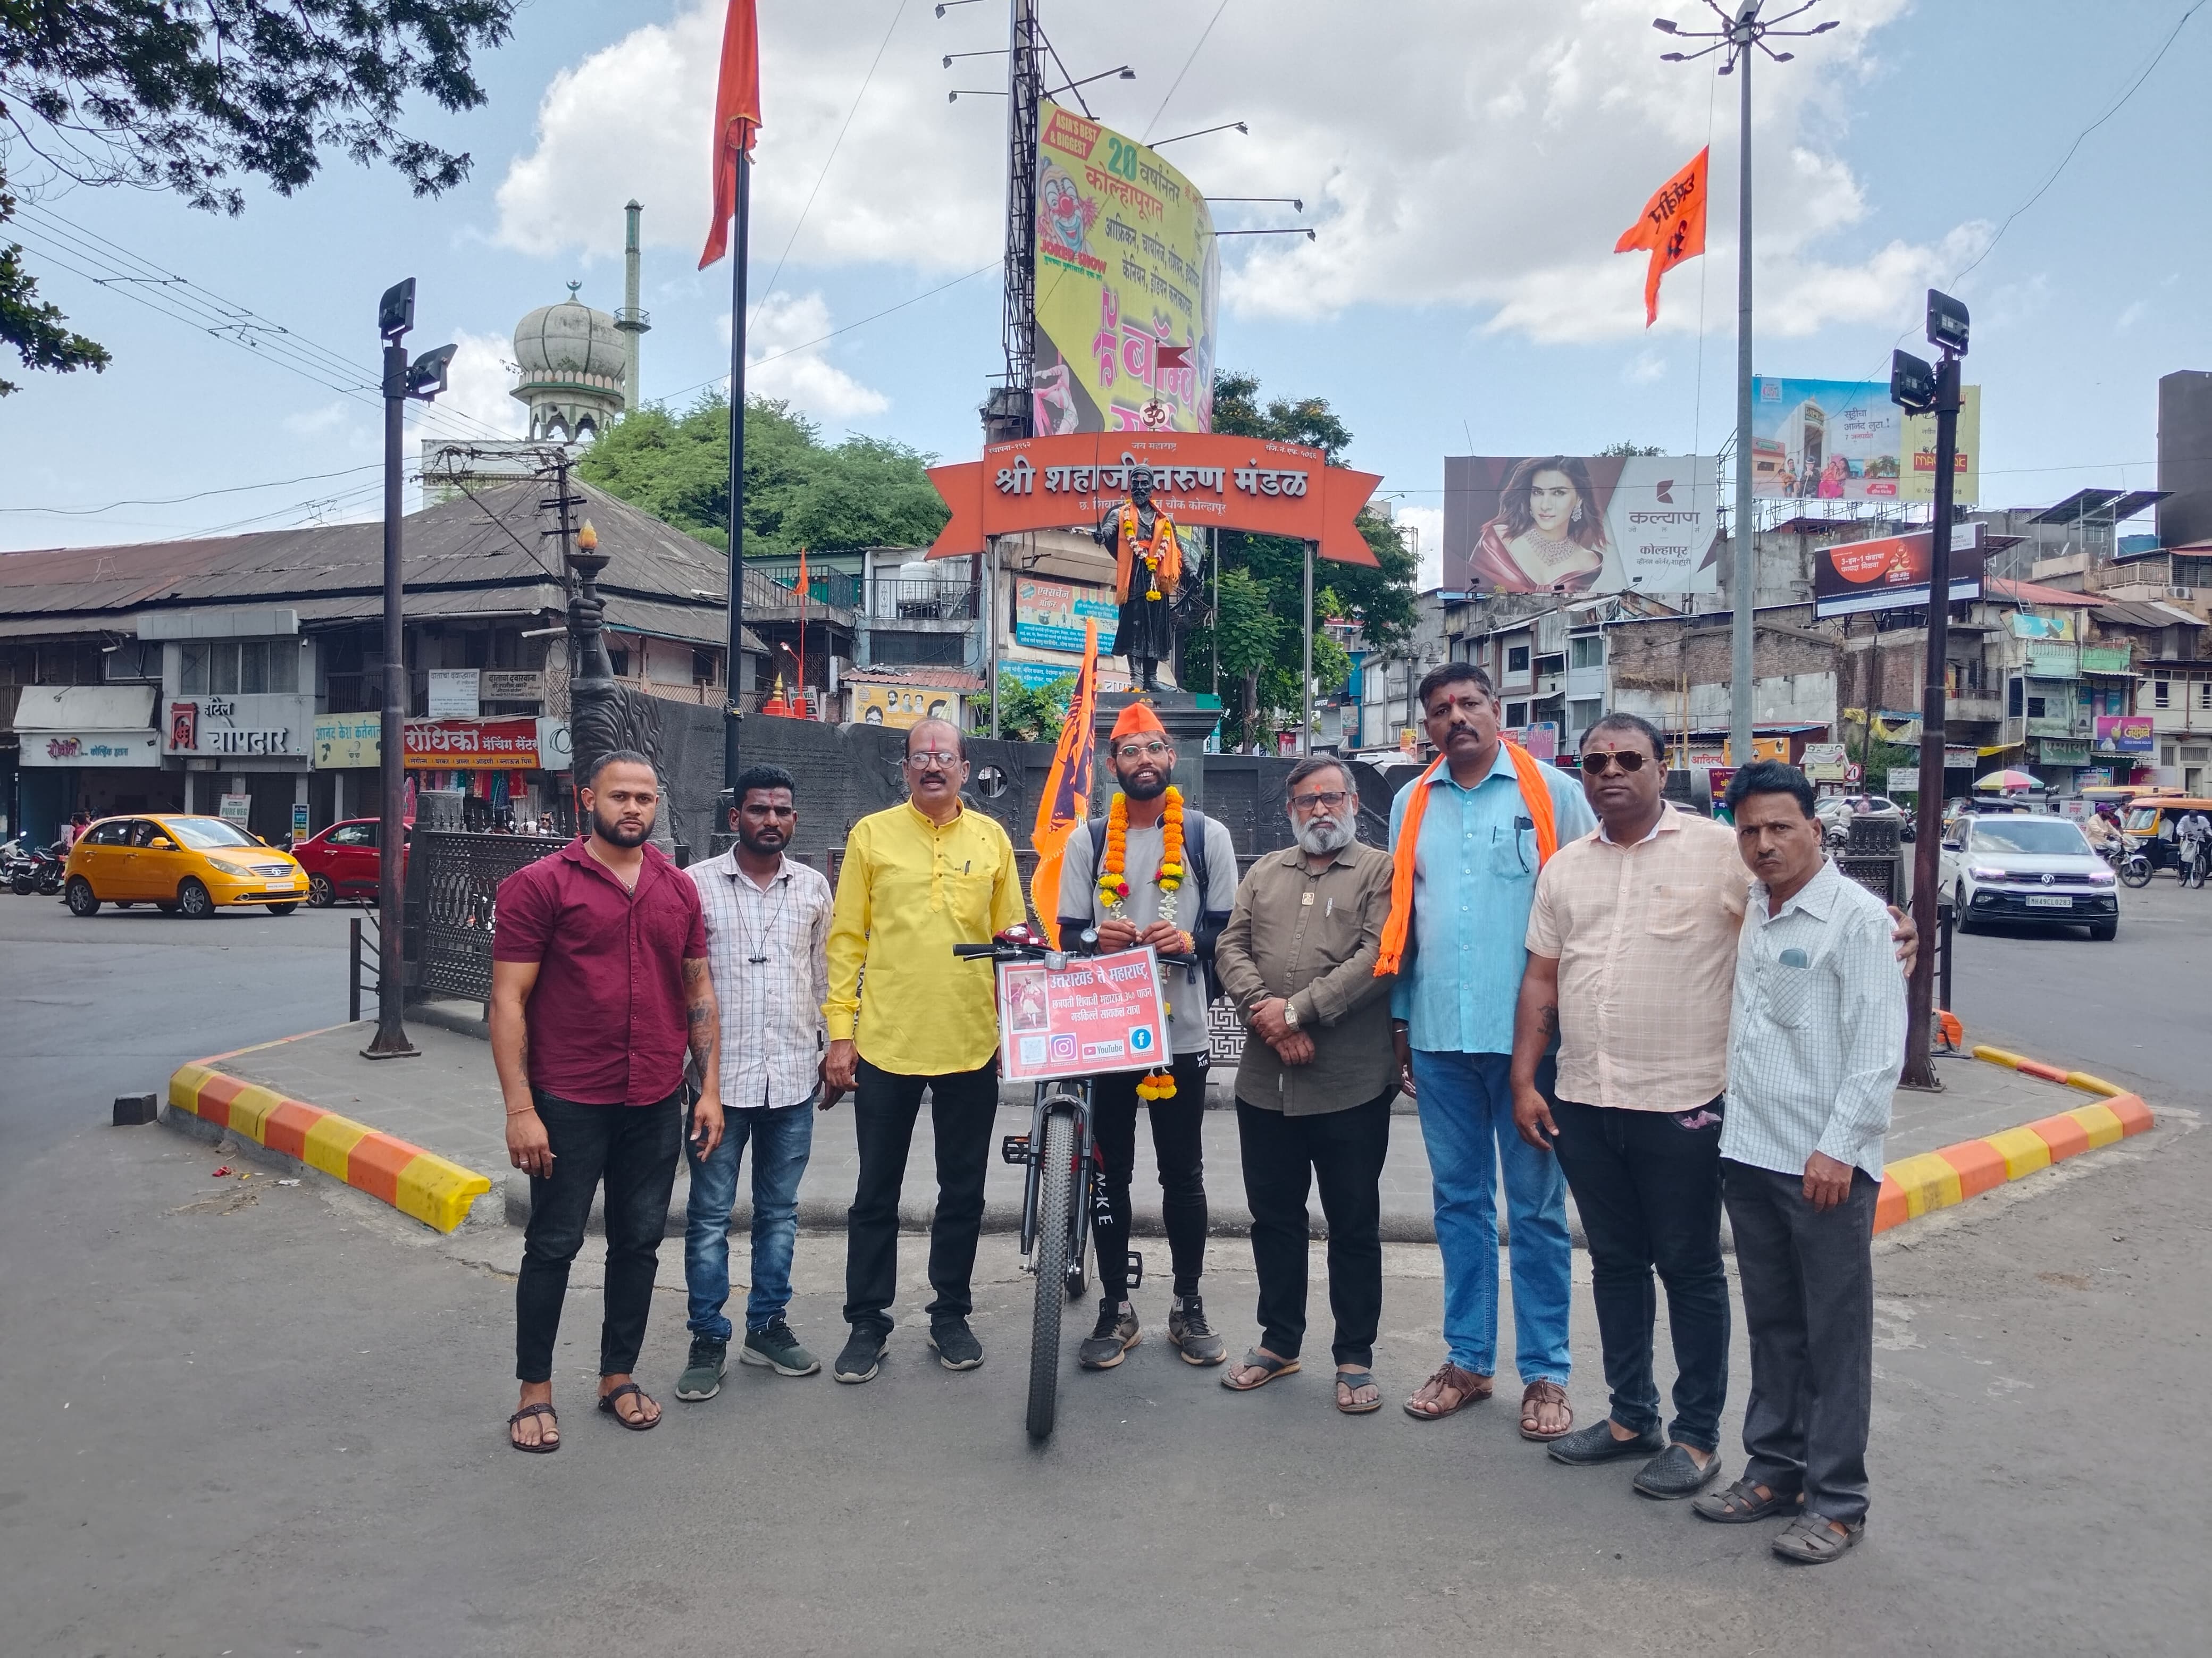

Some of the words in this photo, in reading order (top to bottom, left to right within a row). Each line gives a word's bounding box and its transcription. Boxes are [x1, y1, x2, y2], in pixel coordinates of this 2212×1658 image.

[1056, 114, 1078, 136] ASIA'S
[1080, 123, 1097, 143] BEST
[1050, 130, 1055, 144] &
[1057, 131, 1086, 156] BIGGEST
[1108, 137, 1137, 181] 20
[1084, 161, 1163, 223] कोल्हापूरात
[1040, 239, 1075, 264] JOKER
[1078, 251, 1107, 274] SHOW
[1844, 420, 1865, 431] आनंद
[1149, 442, 1177, 452] महाराष्ट्र
[995, 455, 1036, 494] श्री
[1151, 465, 1226, 494] तरुण
[1233, 458, 1309, 497] मंडळ
[1079, 501, 1089, 510] छ.
[1166, 496, 1186, 510] चौक
[1188, 498, 1227, 517] कोल्हापूर
[1629, 512, 1700, 524] कल्याण
[1639, 543, 1688, 558] कोल्हापूर
[1038, 598, 1057, 608] ऑफर
[205, 717, 288, 755] चोपदार
[316, 721, 336, 740] आनंद
[338, 720, 352, 739] केश
[354, 719, 381, 739] कर्तनाल
[1049, 967, 1093, 988] उत्तराखंड
[1096, 966, 1106, 983] ते
[1109, 962, 1149, 982] महाराष्ट्र
[1052, 996, 1074, 1009] छत्रपती
[1076, 992, 1098, 1007] शिवाजी
[1137, 988, 1152, 998] पावन
[1070, 1008, 1098, 1022] गडकिल्ले
[1100, 1007, 1125, 1019] सायकल
[1127, 1005, 1140, 1015] यात्रा
[1097, 1044, 1122, 1055] YouTube
[1198, 1059, 1209, 1068] AIR
